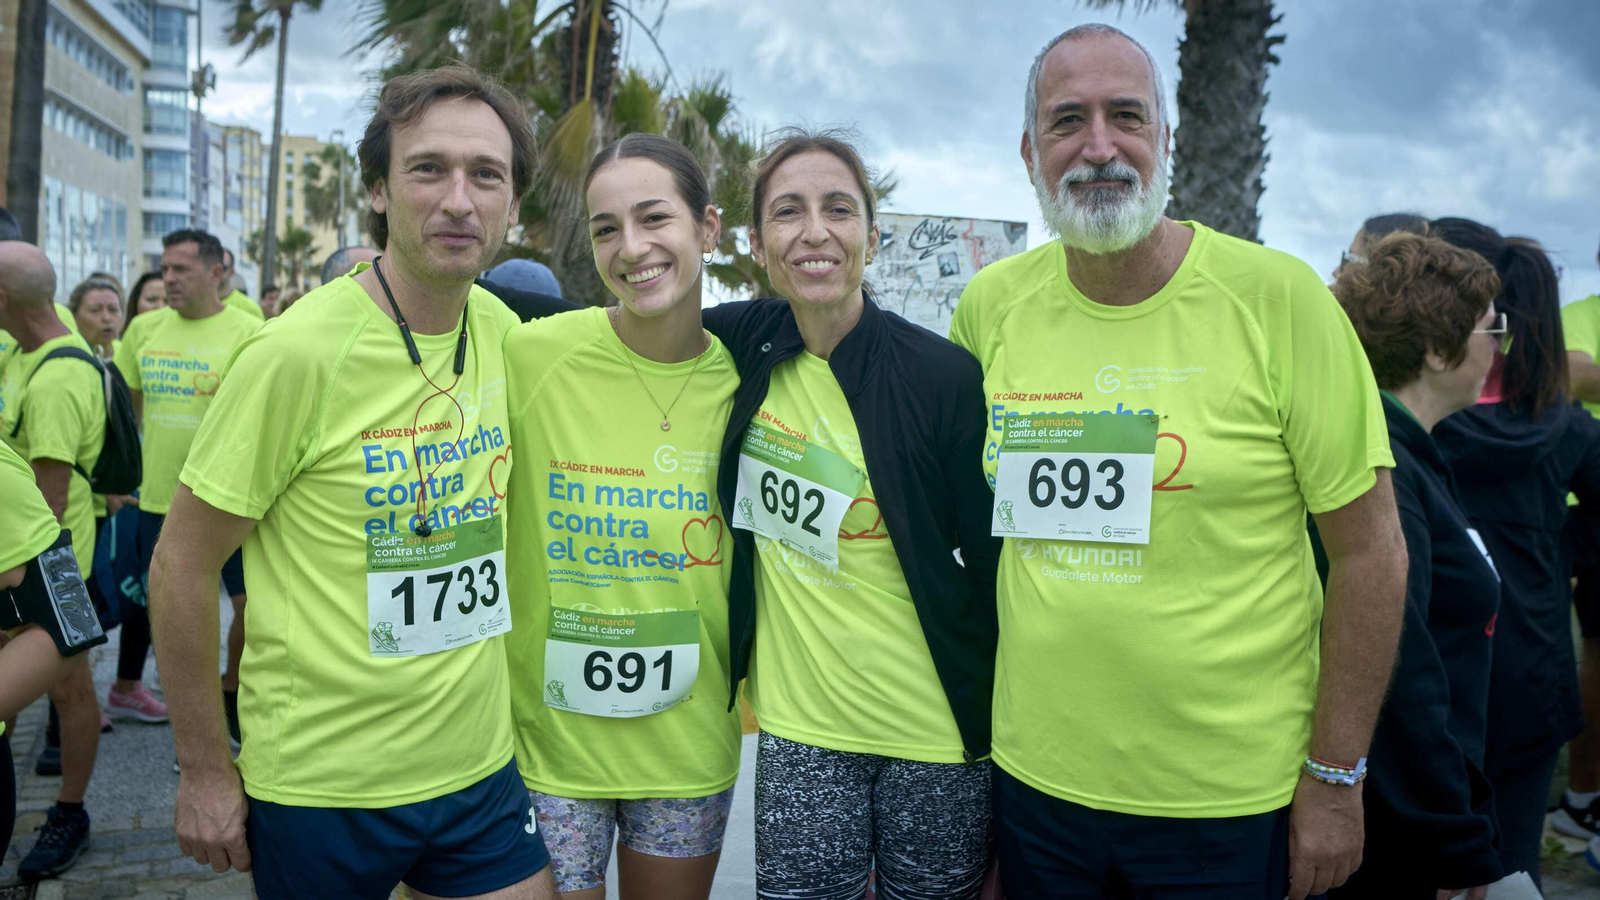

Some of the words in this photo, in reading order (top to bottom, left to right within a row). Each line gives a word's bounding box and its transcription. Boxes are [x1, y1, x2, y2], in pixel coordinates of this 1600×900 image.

[142, 356, 155, 367] En
[158, 359, 209, 372] marcha
[1128, 366, 1168, 374] asociación
[1169, 366, 1207, 374] española
[151, 383, 195, 396] cáncer
[1002, 391, 1028, 401] CÁDIZ
[1029, 393, 1042, 401] EN
[1043, 392, 1083, 400] MARCHA
[361, 430, 372, 440] IX
[372, 427, 403, 439] CÁDIZ
[404, 427, 418, 437] EN
[419, 420, 452, 433] MARCHA
[761, 411, 773, 422] EN
[772, 417, 807, 441] MARCHA
[1008, 418, 1032, 428] Cádiz
[1046, 417, 1084, 427] marcha
[1009, 428, 1036, 438] contra
[1038, 427, 1047, 437] el
[1049, 427, 1084, 437] cáncer
[362, 444, 408, 474] En
[415, 424, 505, 467] marcha
[746, 435, 768, 449] contra
[769, 443, 777, 452] el
[777, 447, 804, 461] cáncer
[748, 424, 766, 438] Cádiz
[766, 433, 776, 441] en
[776, 438, 806, 452] marcha
[550, 460, 559, 469] IX
[560, 461, 588, 473] CÁDIZ
[590, 465, 603, 474] EN
[605, 467, 646, 477] MARCHA
[365, 472, 464, 507] contra
[548, 472, 585, 504] En
[595, 483, 709, 512] marcha
[1028, 458, 1125, 511] 693
[364, 511, 400, 535] el
[409, 495, 498, 532] cáncer
[760, 470, 825, 538] 692
[547, 510, 649, 539] contra
[372, 536, 404, 547] Cádiz
[406, 537, 421, 545] en
[424, 530, 456, 544] marcha
[375, 547, 413, 557] contra
[415, 545, 427, 555] el
[429, 541, 457, 553] cáncer
[547, 536, 578, 562] el
[584, 542, 688, 572] cáncer
[1042, 543, 1142, 567] HYUNDAI
[548, 569, 586, 579] ASOCIACIÓN
[586, 572, 620, 581] ESPAÑOLA
[620, 575, 644, 584] CONTRA
[653, 575, 679, 585] CÁNCER
[1041, 566, 1099, 582] Guadalete
[1102, 572, 1143, 584] Motor
[391, 558, 500, 626] 1733
[553, 610, 581, 622] Cádiz
[582, 616, 596, 624] en
[597, 617, 636, 626] marcha
[554, 621, 587, 632] contra
[588, 624, 599, 633] el
[600, 626, 636, 635] cáncer
[583, 650, 673, 693] 691
